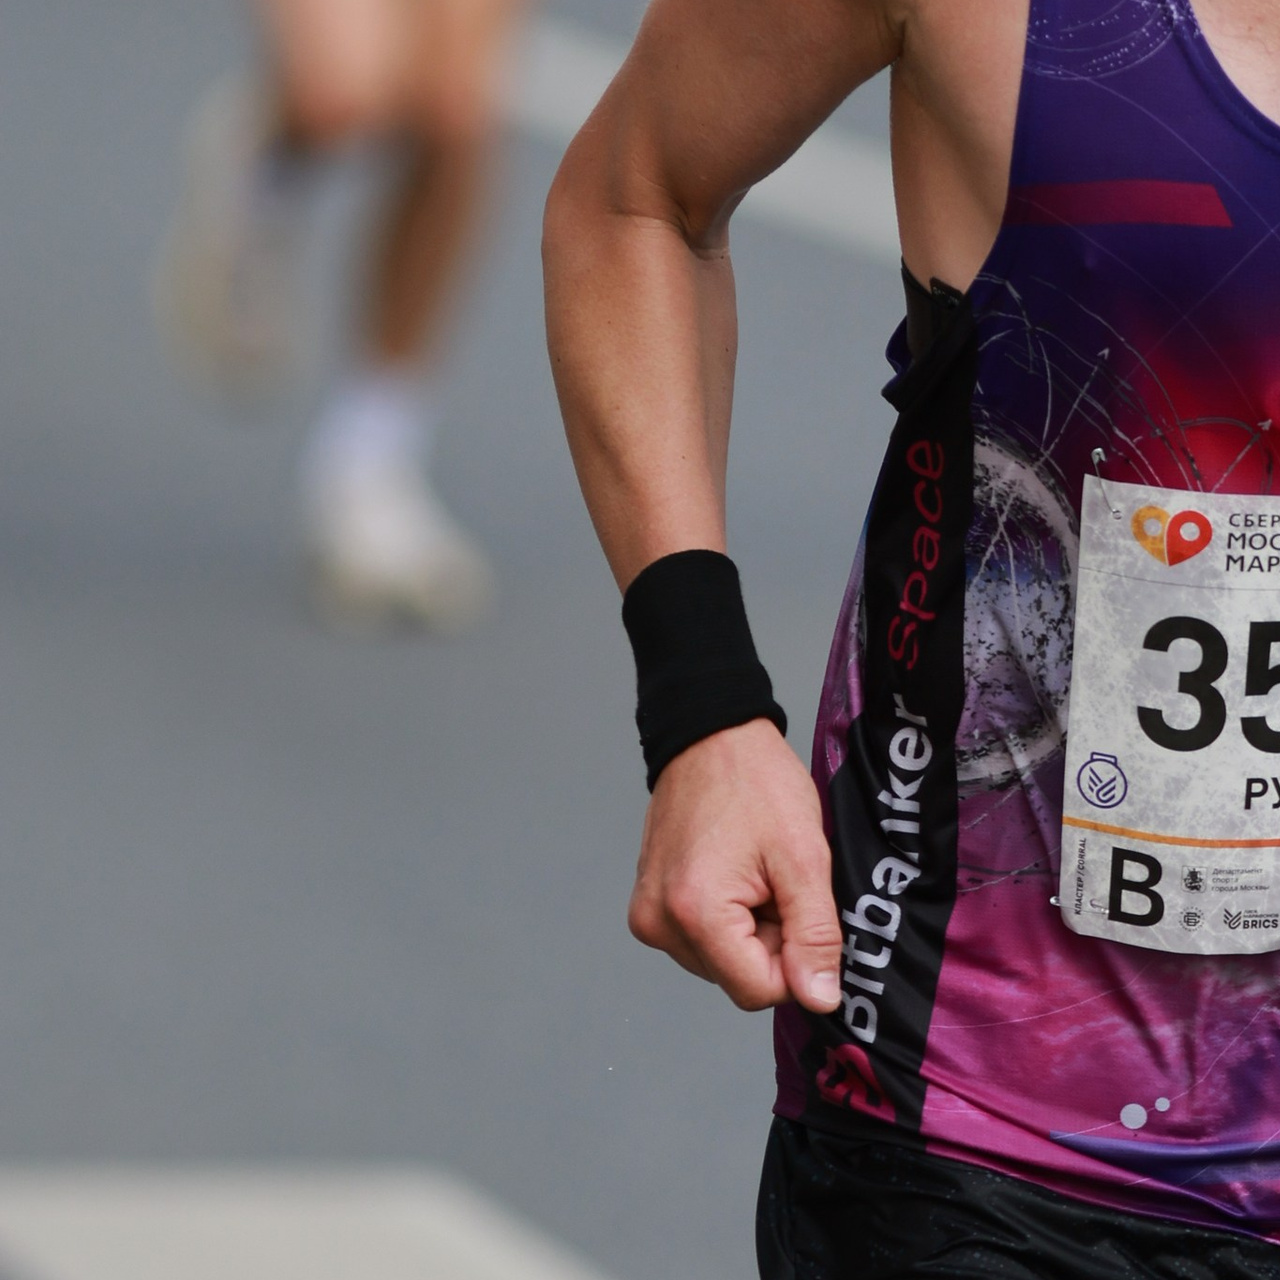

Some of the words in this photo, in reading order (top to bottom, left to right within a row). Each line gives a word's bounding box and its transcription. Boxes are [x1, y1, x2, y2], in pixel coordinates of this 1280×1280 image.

[888, 439, 944, 671] Space
[1078, 837, 1087, 870] CORRAL
[1074, 877, 1084, 915] КЛАСТЕР
[1243, 919, 1279, 929] BRICS
